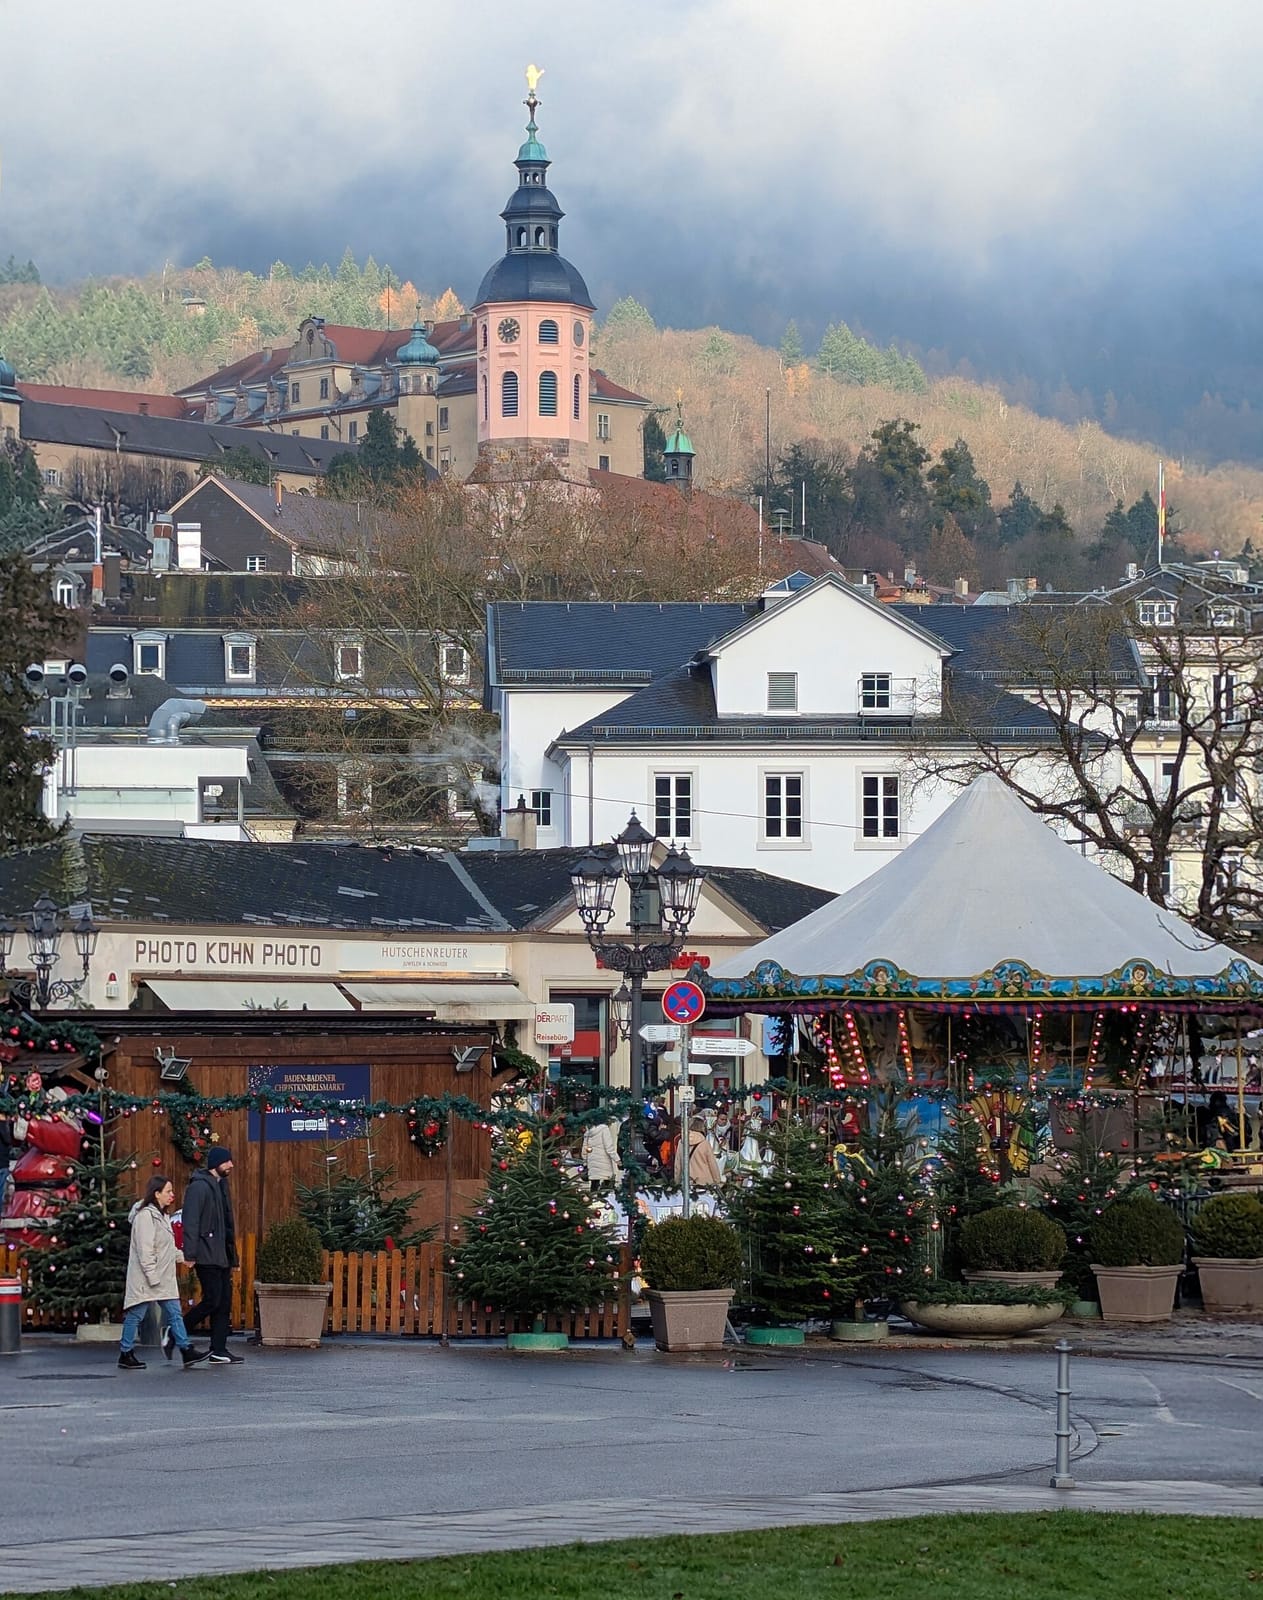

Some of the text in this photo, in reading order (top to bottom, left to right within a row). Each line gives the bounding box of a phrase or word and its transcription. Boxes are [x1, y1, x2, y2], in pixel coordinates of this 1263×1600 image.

[135, 940, 321, 966] PHOTO KÜHN PHOTO
[382, 947, 468, 959] HUTSCHENREUTER
[536, 1012, 568, 1023] DERPART
[536, 1033, 568, 1041] Reisebüro
[284, 1074, 336, 1082] BADEN-BADENER
[274, 1083, 345, 1091] CHRISTKINDELSMARKT
